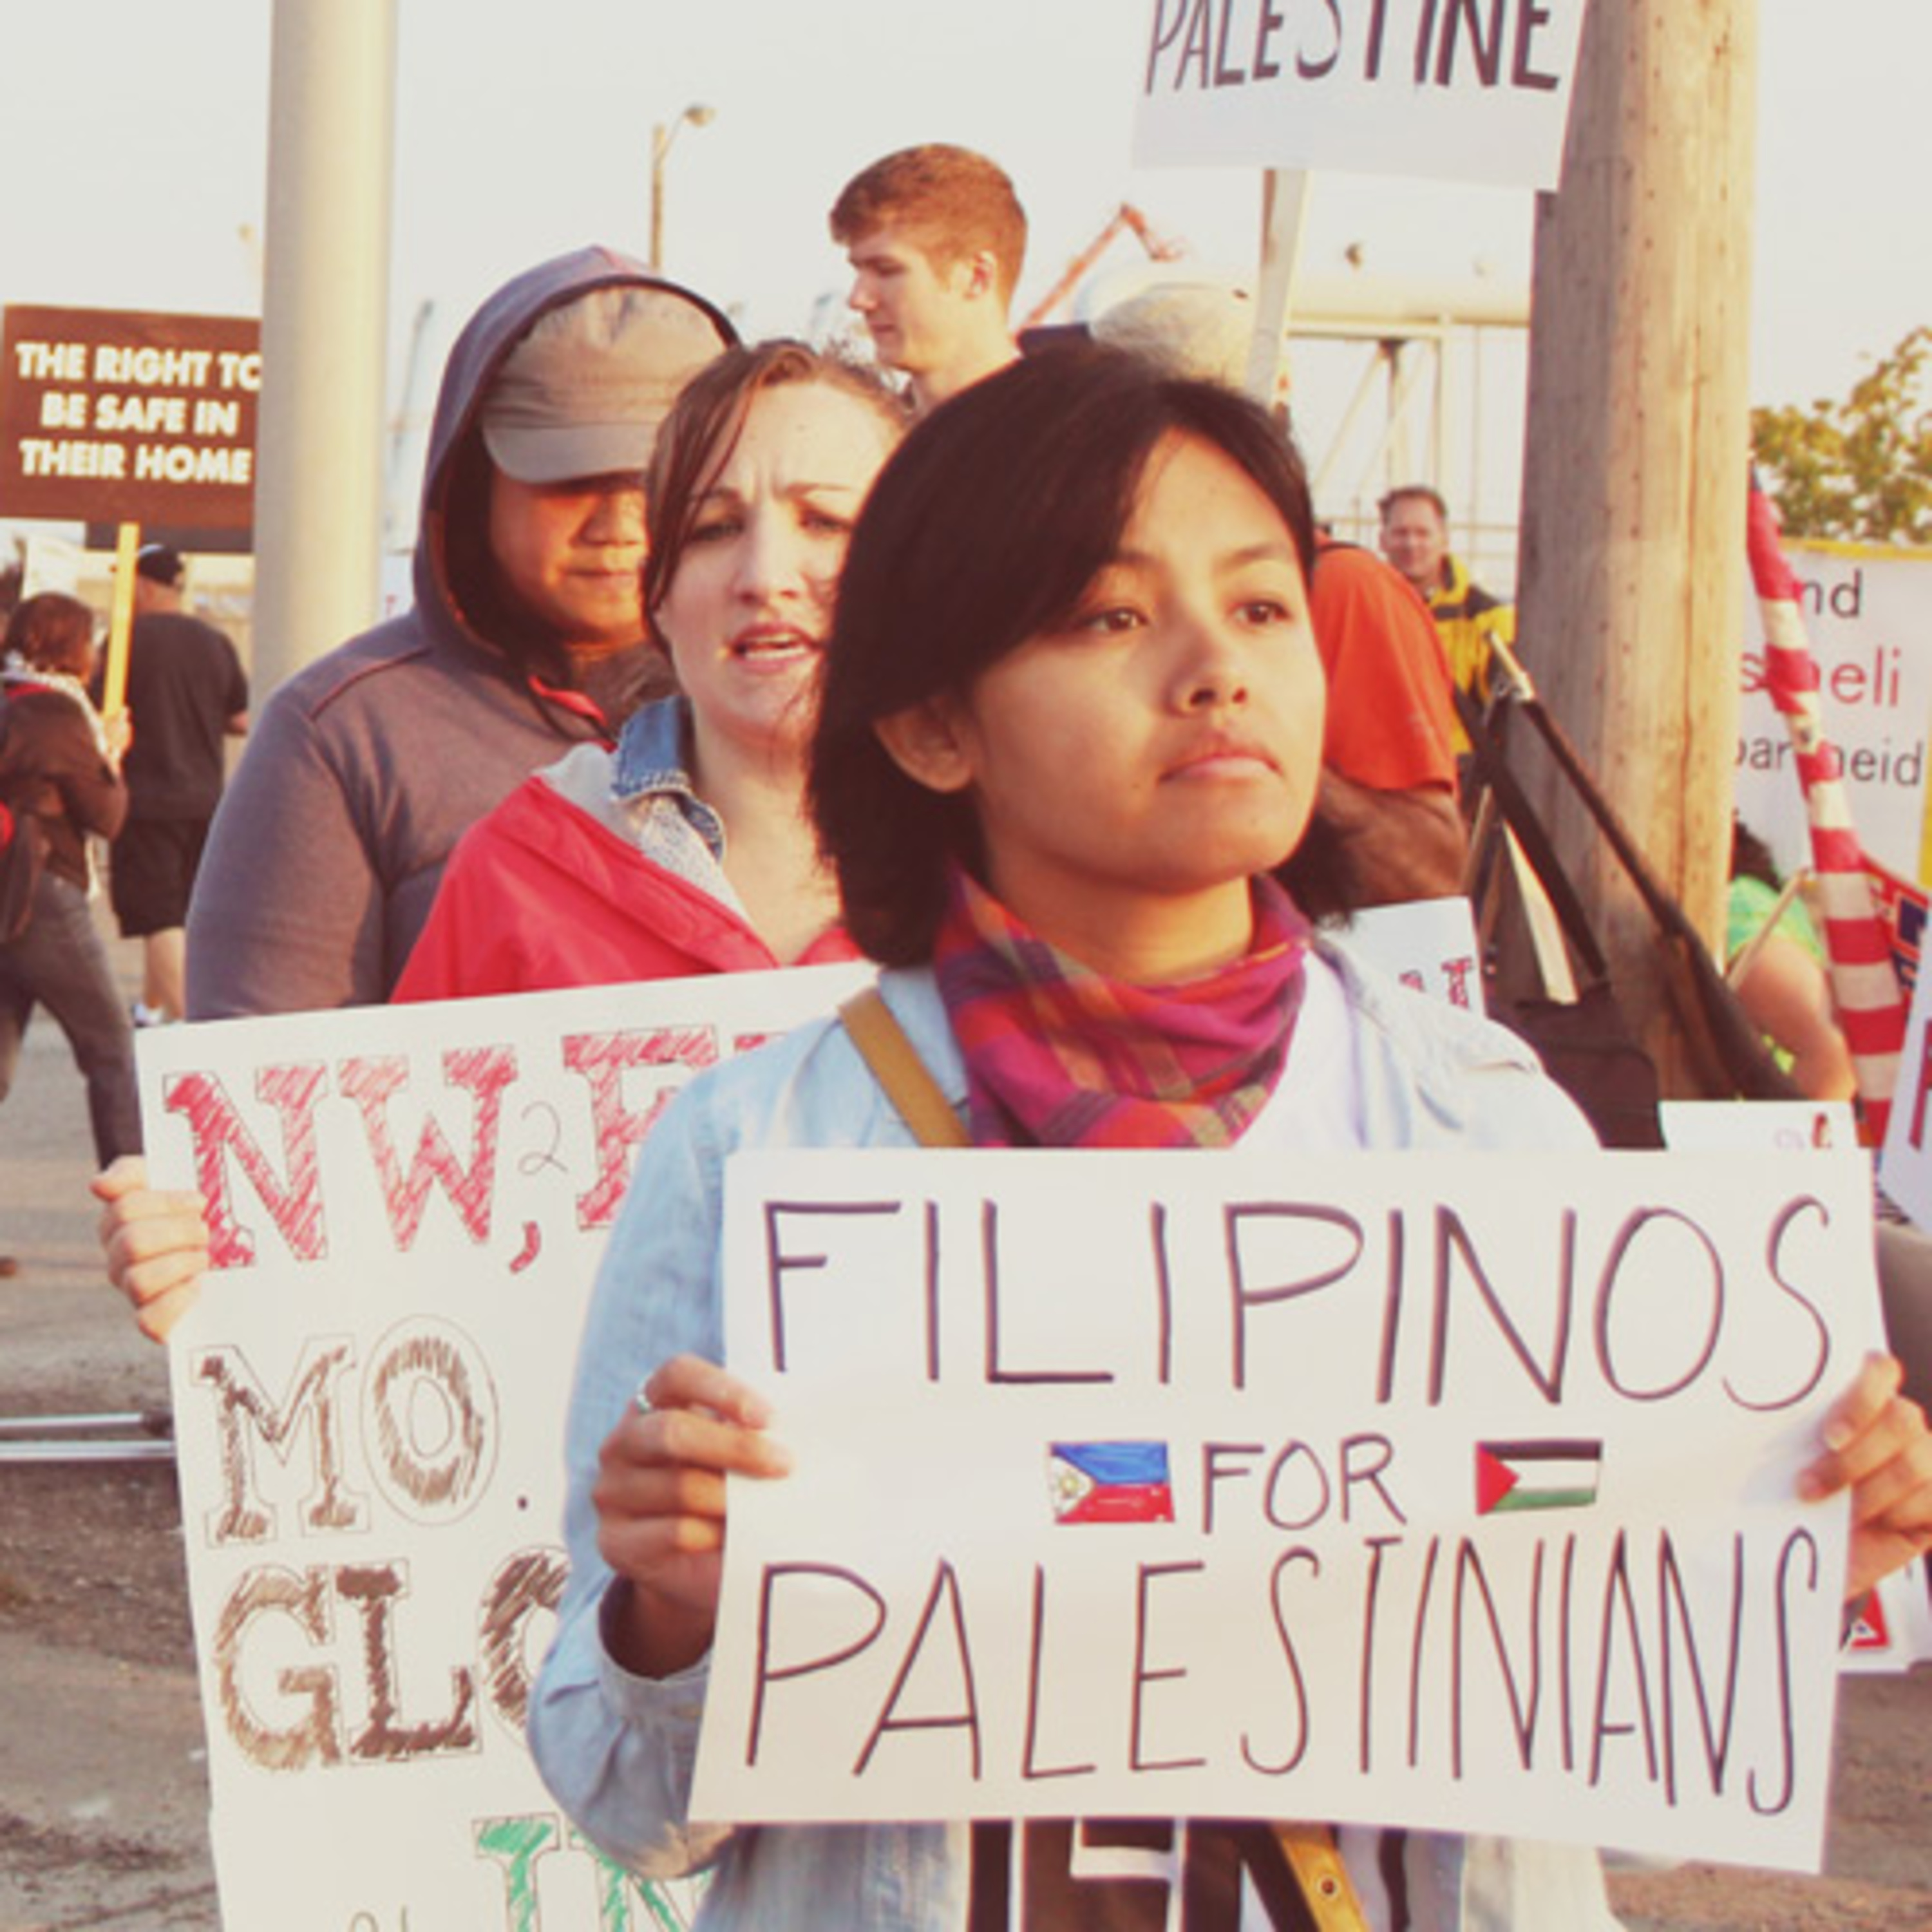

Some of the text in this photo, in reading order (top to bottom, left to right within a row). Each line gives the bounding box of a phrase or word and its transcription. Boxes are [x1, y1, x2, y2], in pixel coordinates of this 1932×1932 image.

[15, 341, 262, 391] THE RIGHT TO
[41, 390, 240, 437] BE SAFE IN
[19, 439, 252, 484] THEIR HOME
[763, 1195, 1831, 1411] FILIPINOS
[1201, 1432, 1407, 1534] FOR
[745, 1527, 1818, 1815] PALESTINIANS
